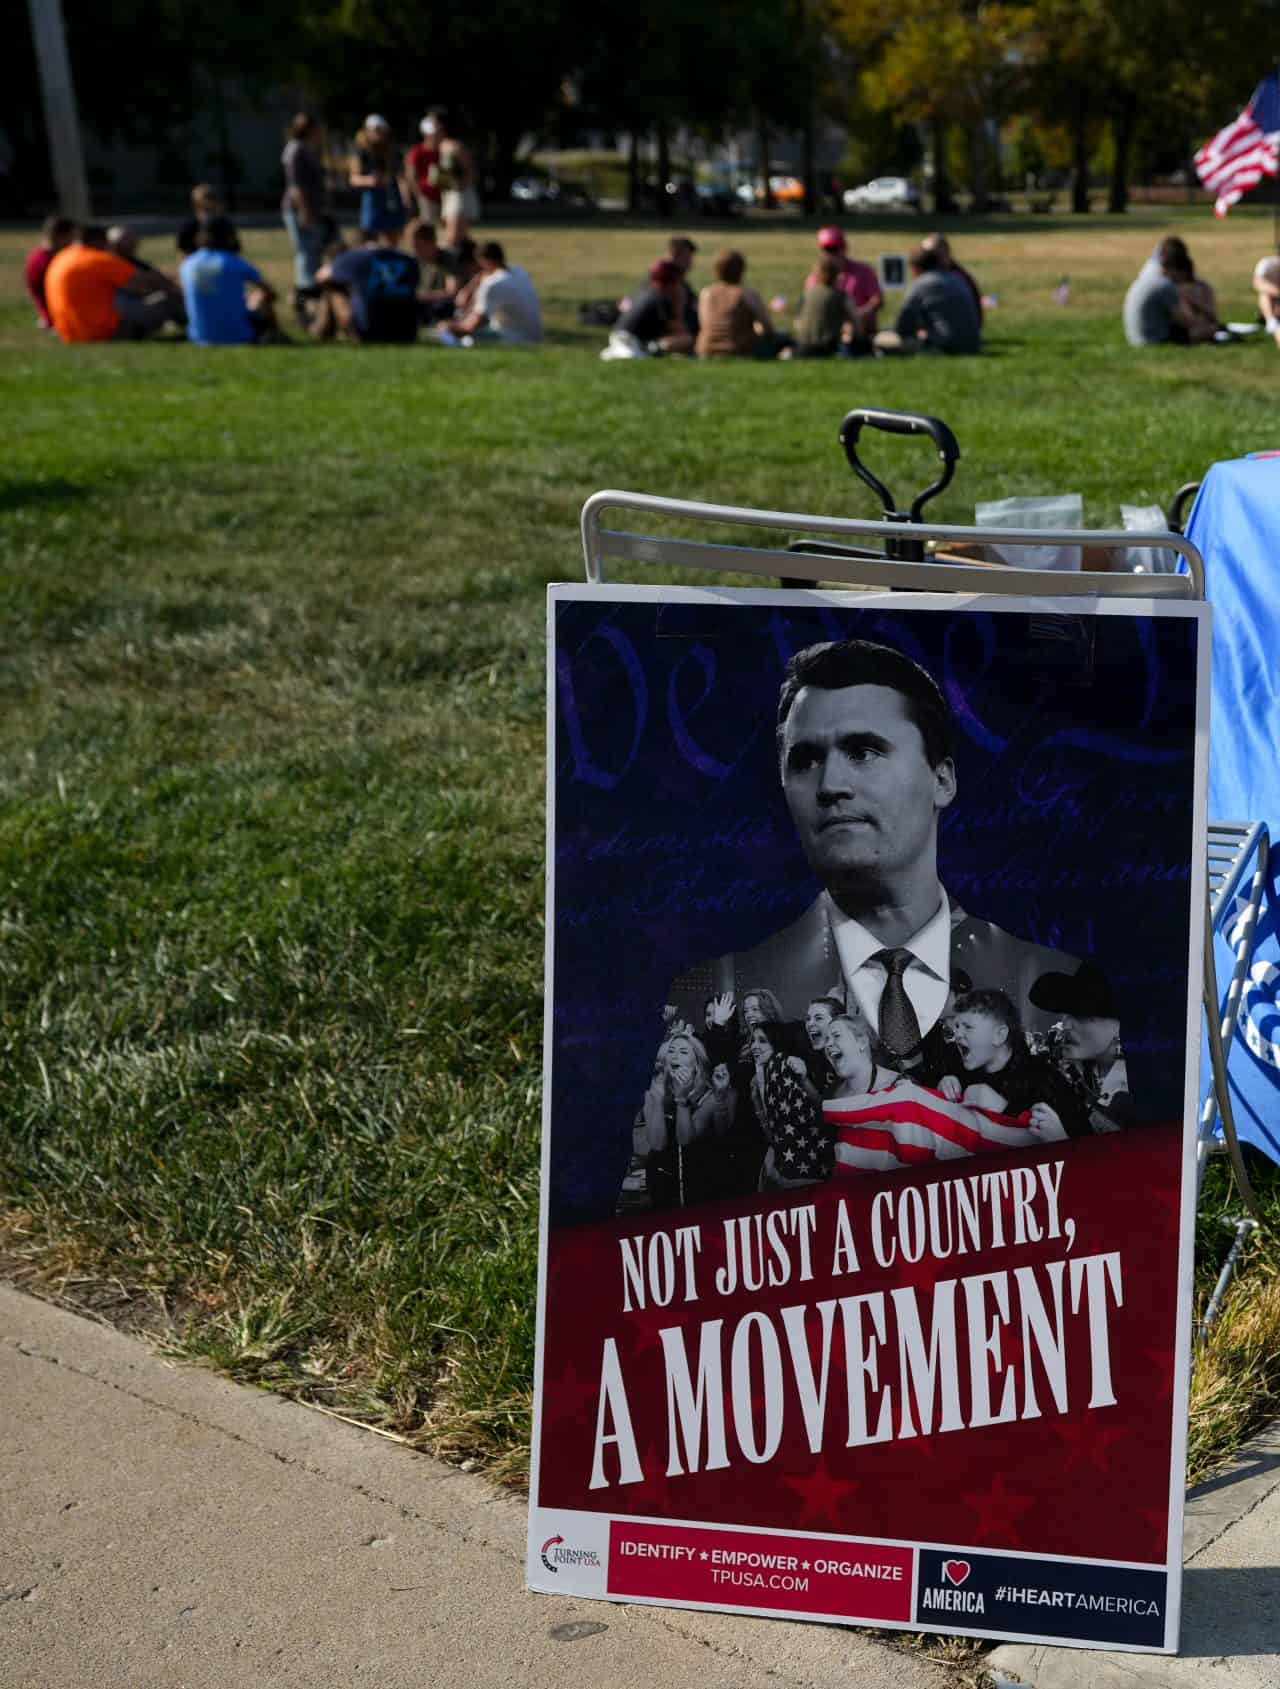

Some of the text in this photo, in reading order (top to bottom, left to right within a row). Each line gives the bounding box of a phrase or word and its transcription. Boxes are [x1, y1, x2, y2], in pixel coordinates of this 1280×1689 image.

[618, 1160, 1076, 1313] NOT JUST A COUNTRY,
[588, 1251, 1124, 1490] A MOVEMENT
[553, 1548, 597, 1560] TURNING
[620, 1540, 904, 1582] IDENTIFY EMPOWER ORGANIZE
[710, 1568, 810, 1593] TPUSA.COM
[922, 1587, 985, 1615] AMERICA
[995, 1585, 1160, 1617] #iHEARTAMERICA
